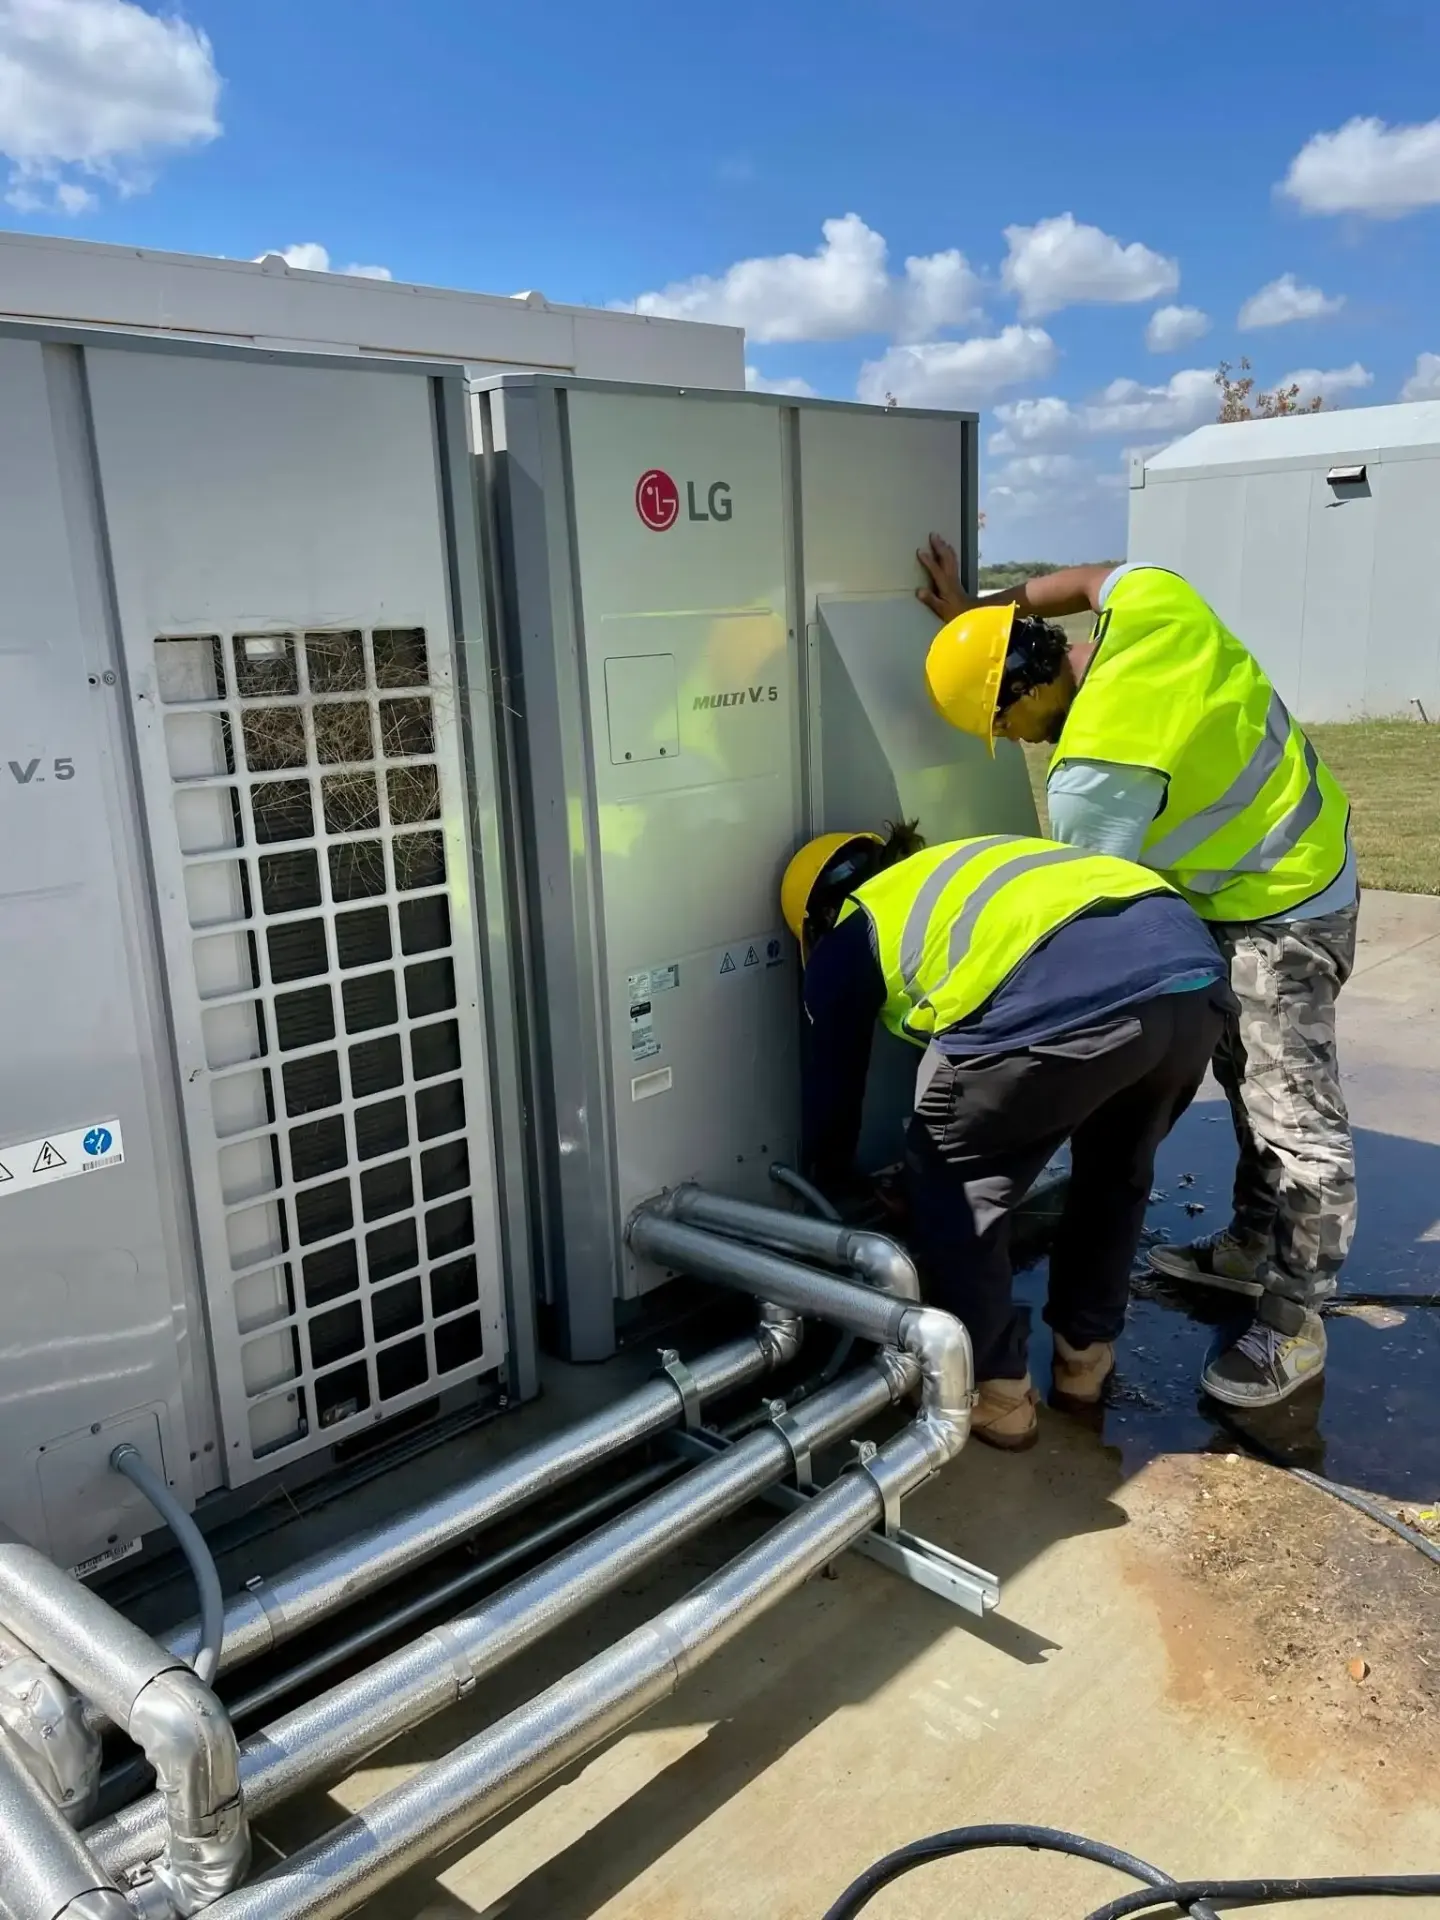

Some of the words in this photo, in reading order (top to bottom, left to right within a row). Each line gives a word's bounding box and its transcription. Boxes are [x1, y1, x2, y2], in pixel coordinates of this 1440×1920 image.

[687, 481, 732, 522] LG
[692, 691, 745, 710] MULTI
[768, 686, 778, 702] 5
[54, 757, 75, 781] 5
